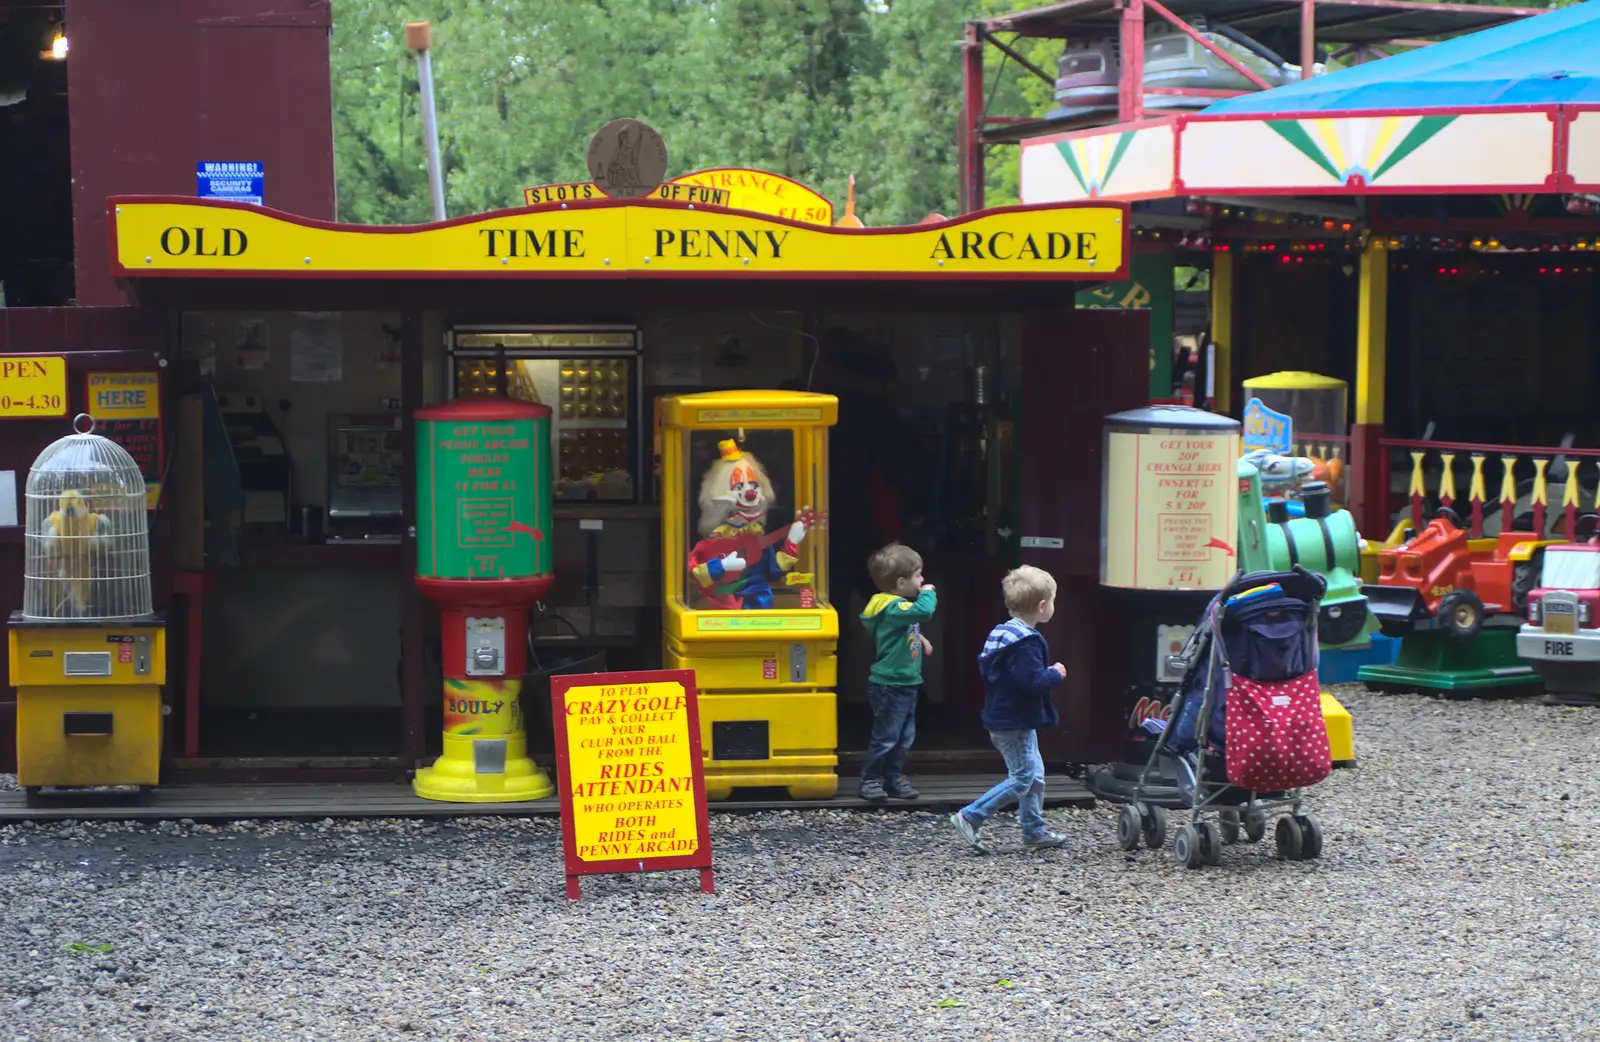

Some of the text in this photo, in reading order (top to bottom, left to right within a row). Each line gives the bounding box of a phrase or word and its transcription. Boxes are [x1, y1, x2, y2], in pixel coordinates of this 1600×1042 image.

[691, 172, 787, 198] NTRANCE
[531, 184, 593, 204] SLOTS
[661, 184, 680, 200] OF
[688, 187, 722, 205] FUN
[160, 226, 1098, 261] OLD TIME PENNY ARCADE
[97, 389, 147, 405] HERE
[453, 425, 515, 437] GET YOUR
[439, 438, 529, 451] PENNY ARCADE
[1160, 440, 1215, 450] GET YOUR
[460, 453, 509, 464] TOKENS
[1146, 462, 1223, 472] CHANGE HERE
[1158, 478, 1200, 488] INSERT
[1176, 490, 1199, 499] FOR
[1544, 641, 1574, 656] FIRE
[600, 686, 650, 697] TO PLAY
[565, 695, 687, 716] CRAZY GOLF
[580, 712, 676, 725] PAY & COLLECT
[611, 725, 646, 736] YOUR
[581, 734, 679, 749] CLUB AND BALL
[598, 746, 663, 759] FROM THE
[600, 761, 665, 780] RIDES
[572, 776, 695, 798] ATTENDANT
[583, 799, 684, 813] WHO OPERATES
[614, 815, 657, 829] BOTH
[597, 828, 677, 843] RIDES and
[579, 839, 699, 857] PENNY ARCADE
